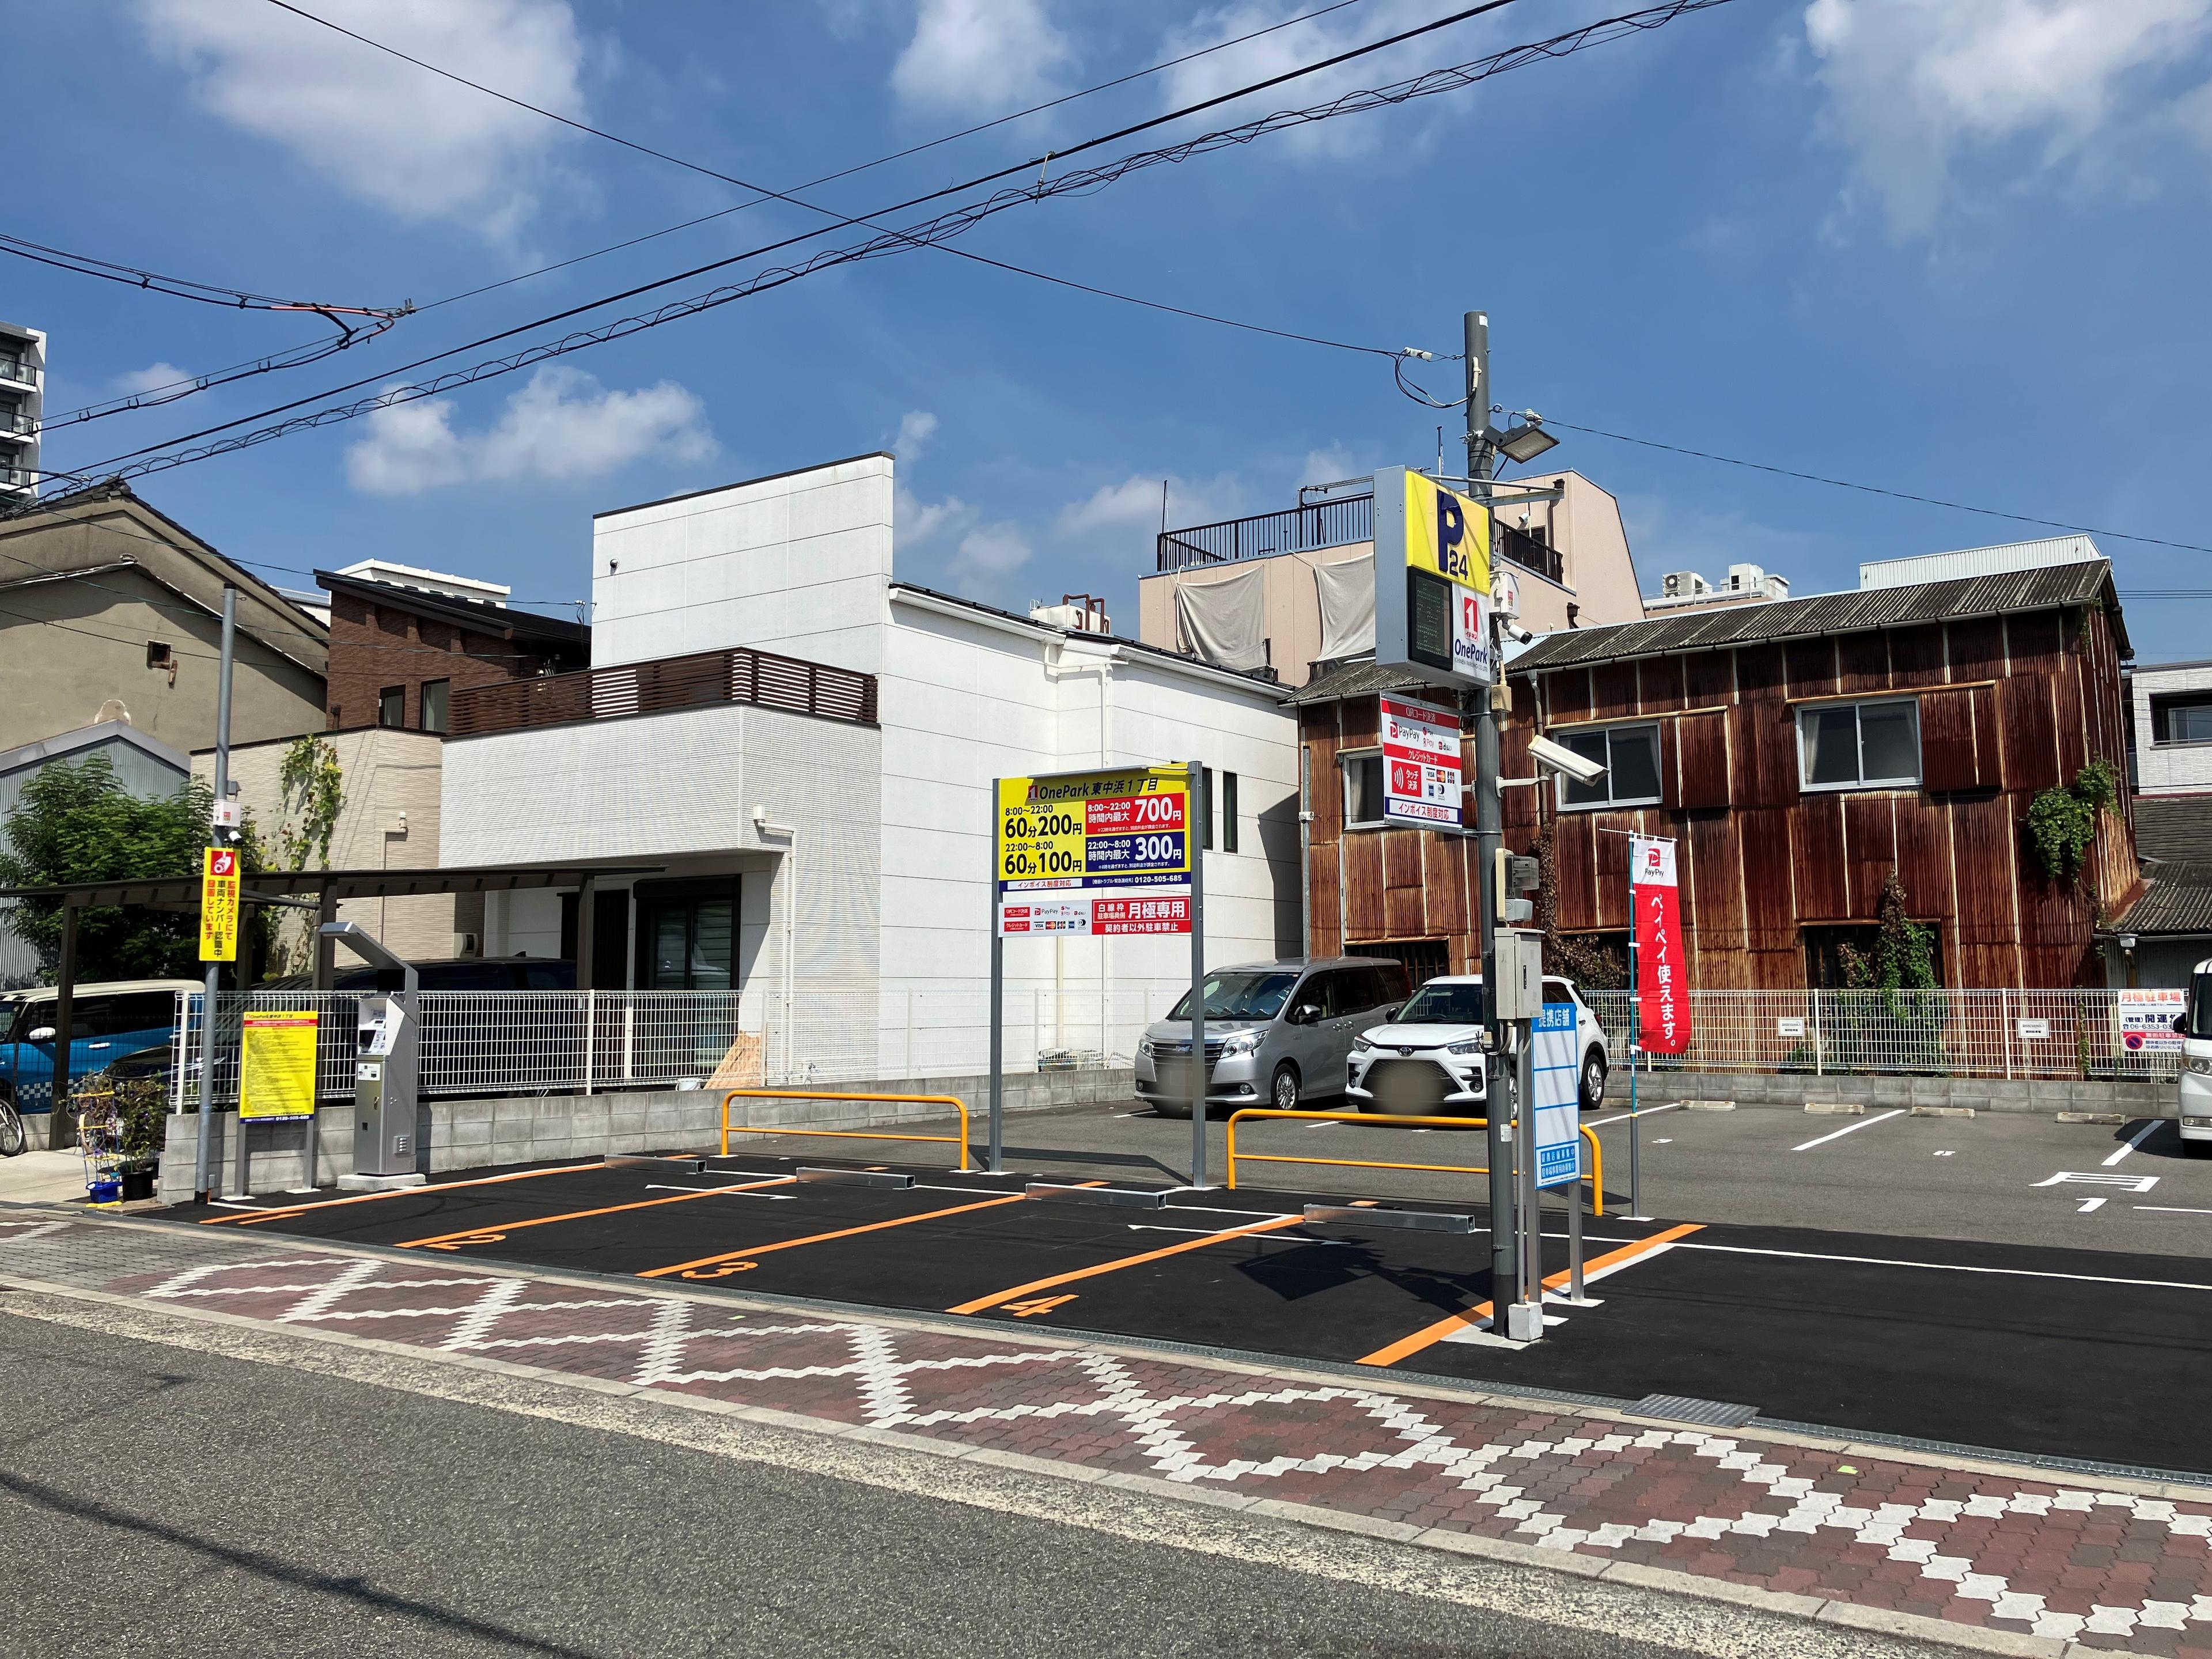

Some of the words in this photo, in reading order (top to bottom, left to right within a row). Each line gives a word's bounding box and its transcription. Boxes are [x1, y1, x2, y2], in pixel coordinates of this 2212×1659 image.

[1437, 489, 1464, 573] P
[1449, 550, 1468, 580] 24
[1455, 638, 1487, 664] OnePark
[1406, 706, 1436, 723] QRコード決済
[1399, 726, 1420, 742] PayPay
[1408, 749, 1438, 764] クレジットカード
[1406, 768, 1419, 780] タッチ
[1039, 783, 1089, 800] OnePark
[1407, 780, 1418, 791] 決済
[1088, 811, 1130, 824] 時間内最大
[1134, 797, 1181, 823] 700円
[1399, 802, 1449, 820] インボイス制度対応
[1088, 849, 1130, 861] 時間内最大
[1135, 835, 1181, 861] 300円
[1135, 875, 1182, 883] 0120-505-685
[1645, 868, 1664, 878] PayPay
[1018, 880, 1071, 888] インボイス制度対応
[225, 880, 236, 940] 監視カメラにて
[1099, 903, 1124, 912] 白線枠
[1128, 901, 1185, 919] 月極専用
[1104, 922, 1179, 933] 契約者以外駐車禁止
[1651, 893, 1676, 1047] ペイペイ使えます。
[2122, 991, 2181, 1002] 月極駐車場
[1539, 1008, 1570, 1027] 提携店舗
[425, 1234, 506, 1250] 2
[681, 1261, 759, 1279] 3
[1000, 1294, 1080, 1317] 4
